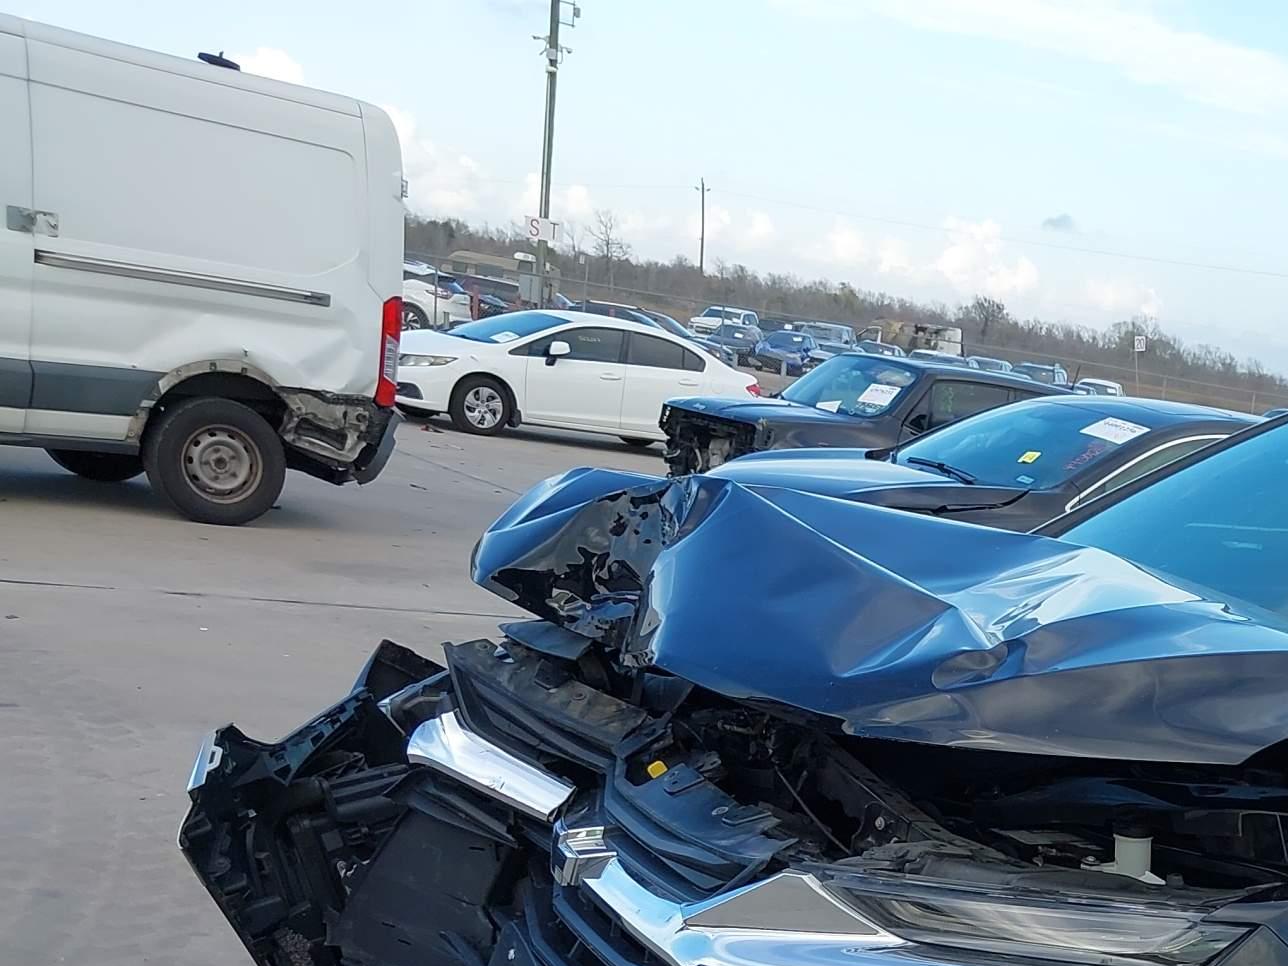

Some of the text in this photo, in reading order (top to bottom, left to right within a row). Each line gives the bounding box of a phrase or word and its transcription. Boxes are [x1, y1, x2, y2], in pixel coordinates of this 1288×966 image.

[529, 218, 560, 240] S T
[1136, 338, 1145, 350] 20
